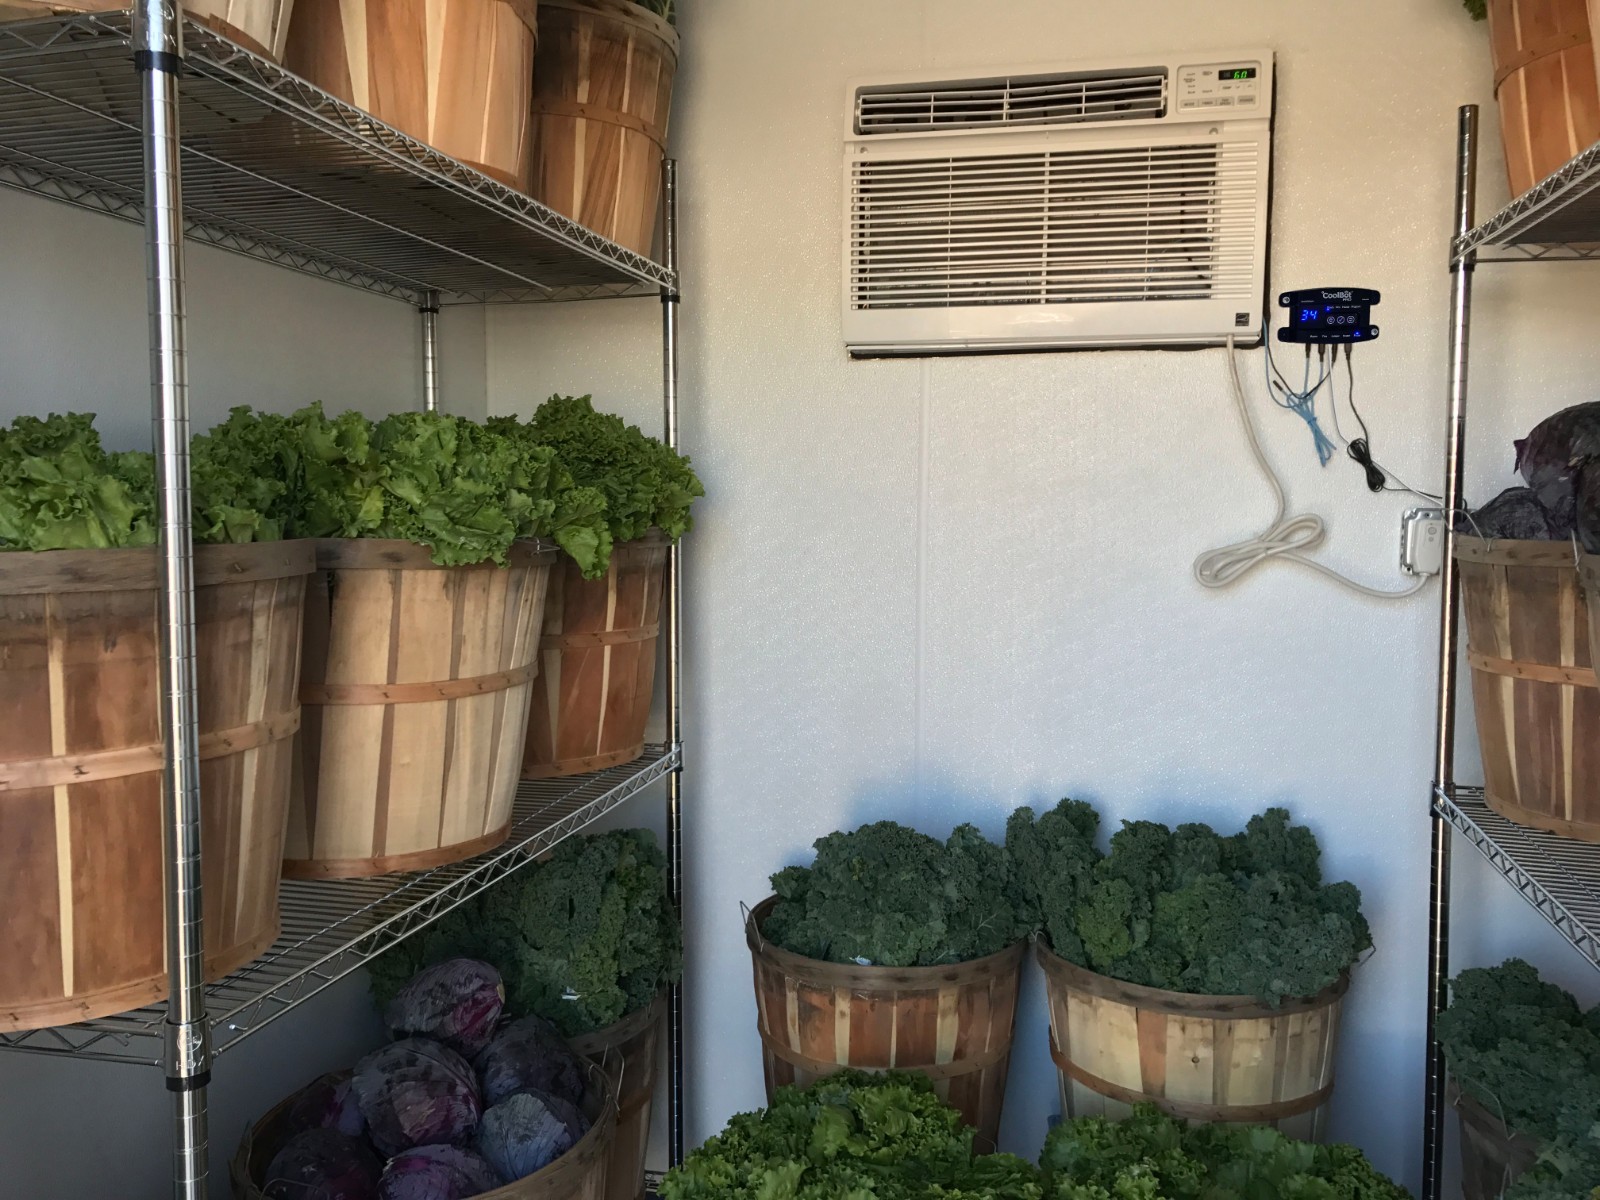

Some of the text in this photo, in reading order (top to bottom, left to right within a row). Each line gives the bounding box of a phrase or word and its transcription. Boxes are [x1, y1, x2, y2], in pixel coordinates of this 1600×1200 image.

[1233, 70, 1248, 79] 60
[1322, 291, 1352, 299] CoolBot
[1301, 309, 1317, 321] 34
